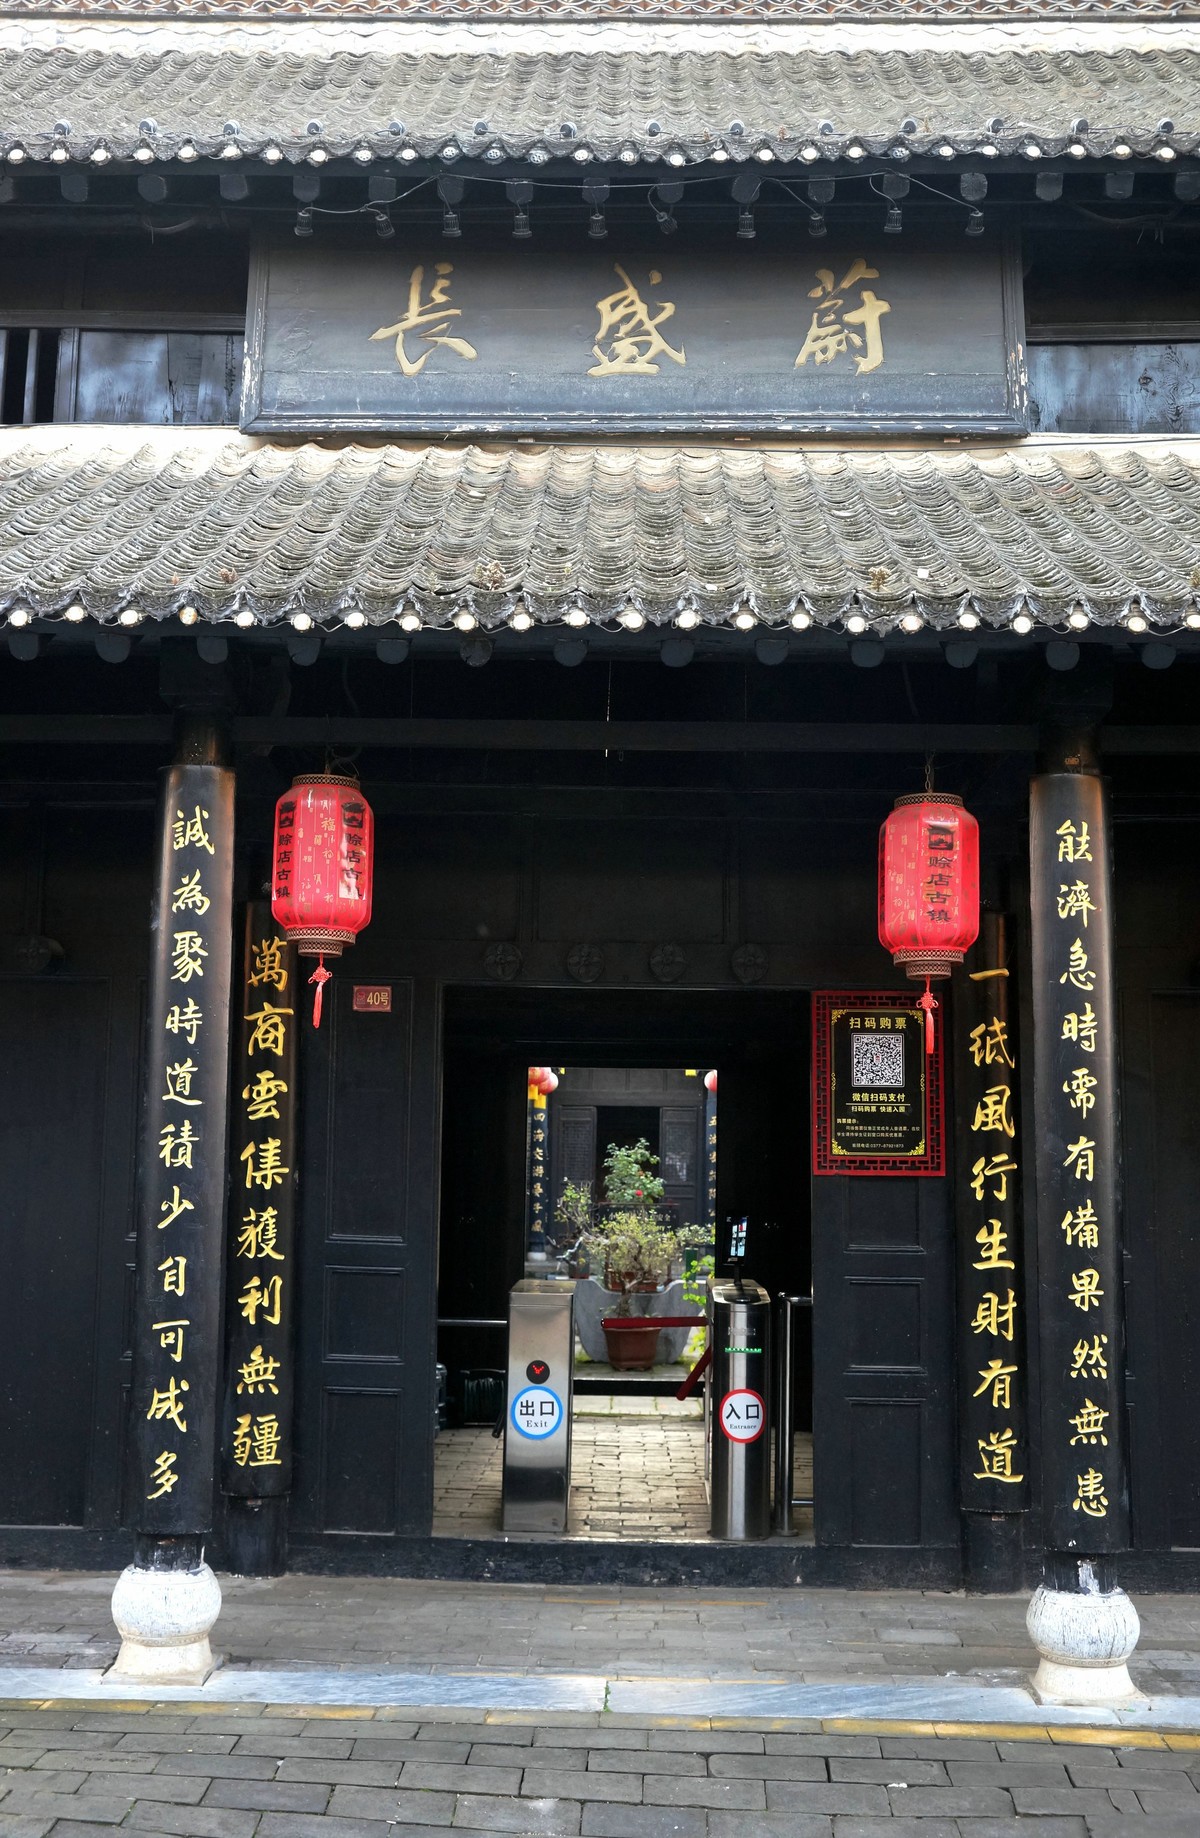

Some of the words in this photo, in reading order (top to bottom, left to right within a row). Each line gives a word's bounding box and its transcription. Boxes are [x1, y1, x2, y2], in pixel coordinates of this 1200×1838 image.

[926, 856, 953, 922] 赊店古镇
[367, 992, 389, 1005] 40号
[849, 1017, 907, 1030] 扫码购票
[852, 1093, 906, 1102] 微信扫码支付
[519, 1400, 555, 1417] 出口
[725, 1403, 760, 1420] 入口
[526, 1419, 548, 1429] Exit
